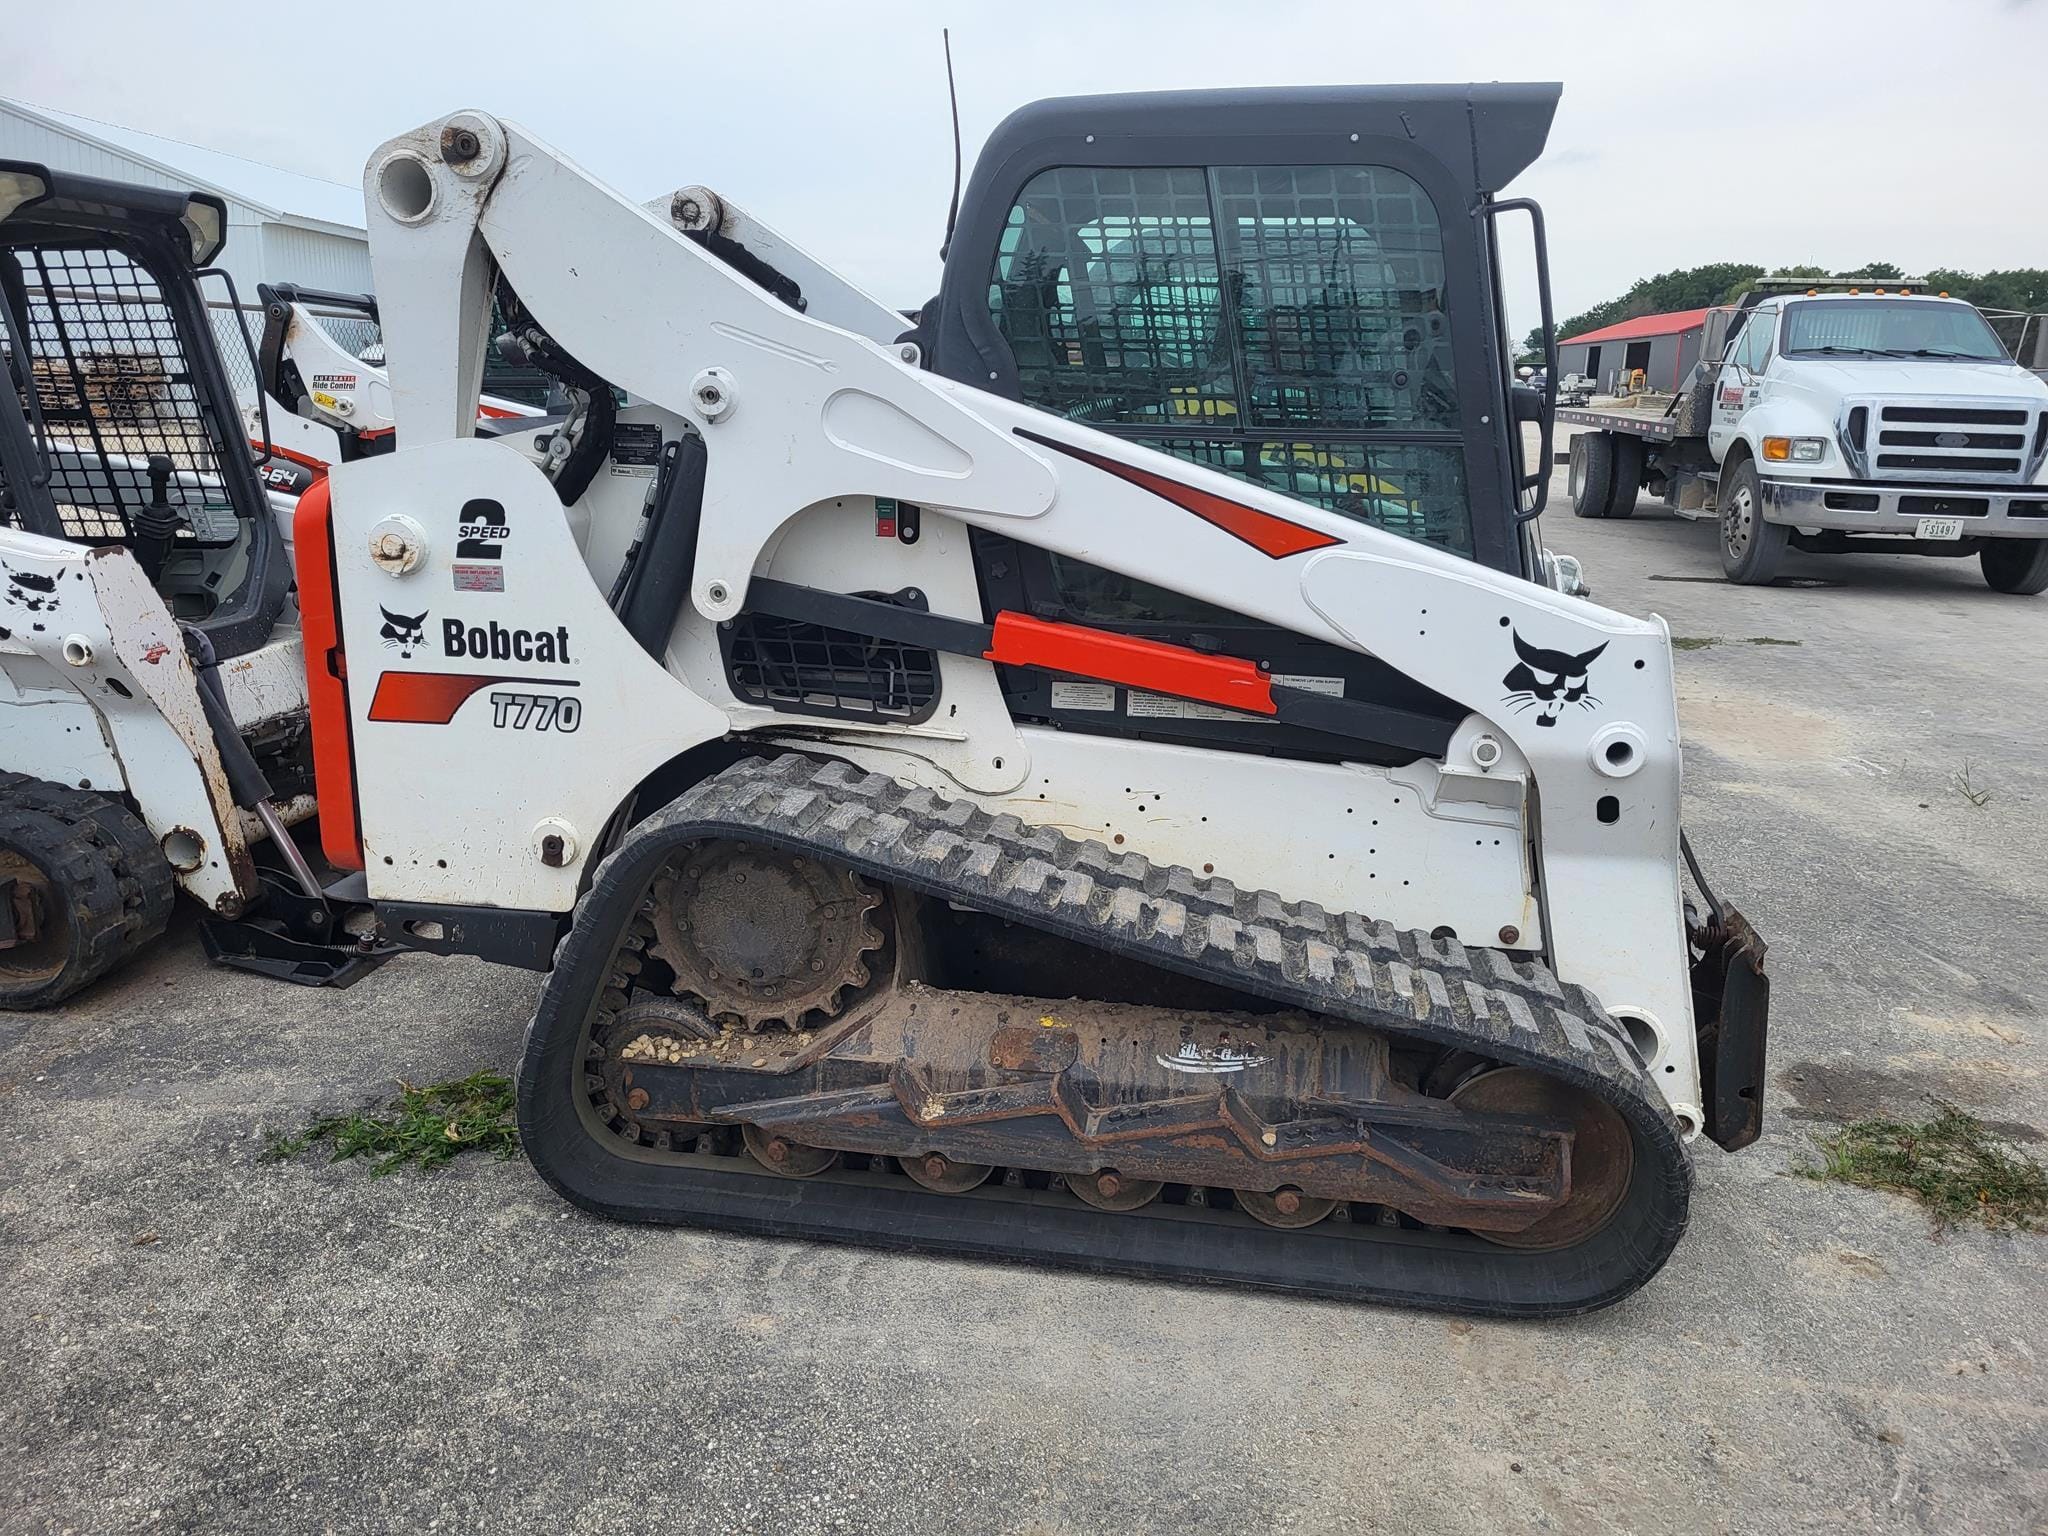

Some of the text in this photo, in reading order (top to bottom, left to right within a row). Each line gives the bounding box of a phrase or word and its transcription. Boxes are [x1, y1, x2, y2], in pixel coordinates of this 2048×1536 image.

[456, 498, 506, 560] 2
[458, 525, 511, 539] SPEED
[442, 618, 570, 664] Bobcat
[490, 692, 582, 733] T770
